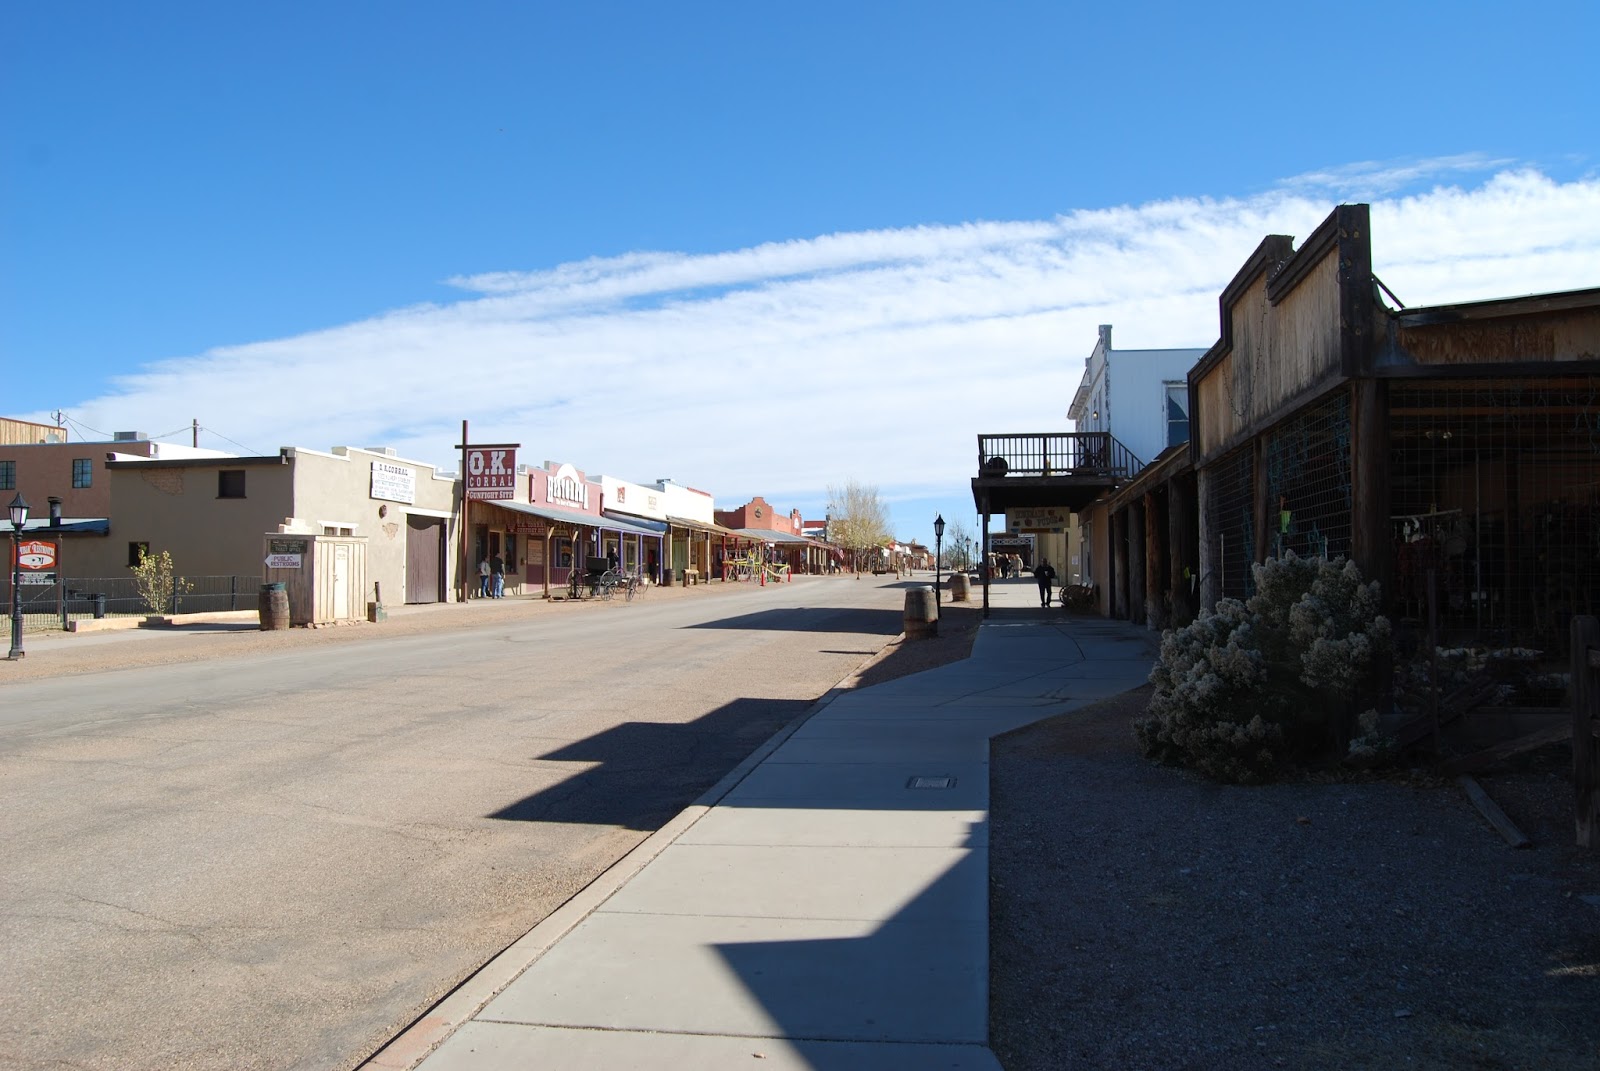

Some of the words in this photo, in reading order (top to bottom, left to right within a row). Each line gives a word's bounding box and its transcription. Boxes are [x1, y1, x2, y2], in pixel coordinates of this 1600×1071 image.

[469, 451, 512, 476] O.K.
[470, 476, 512, 487] CORRAL
[470, 491, 498, 499] GUNFIGHT
[499, 490, 513, 500] SITE
[1037, 516, 1058, 526] FUDGE
